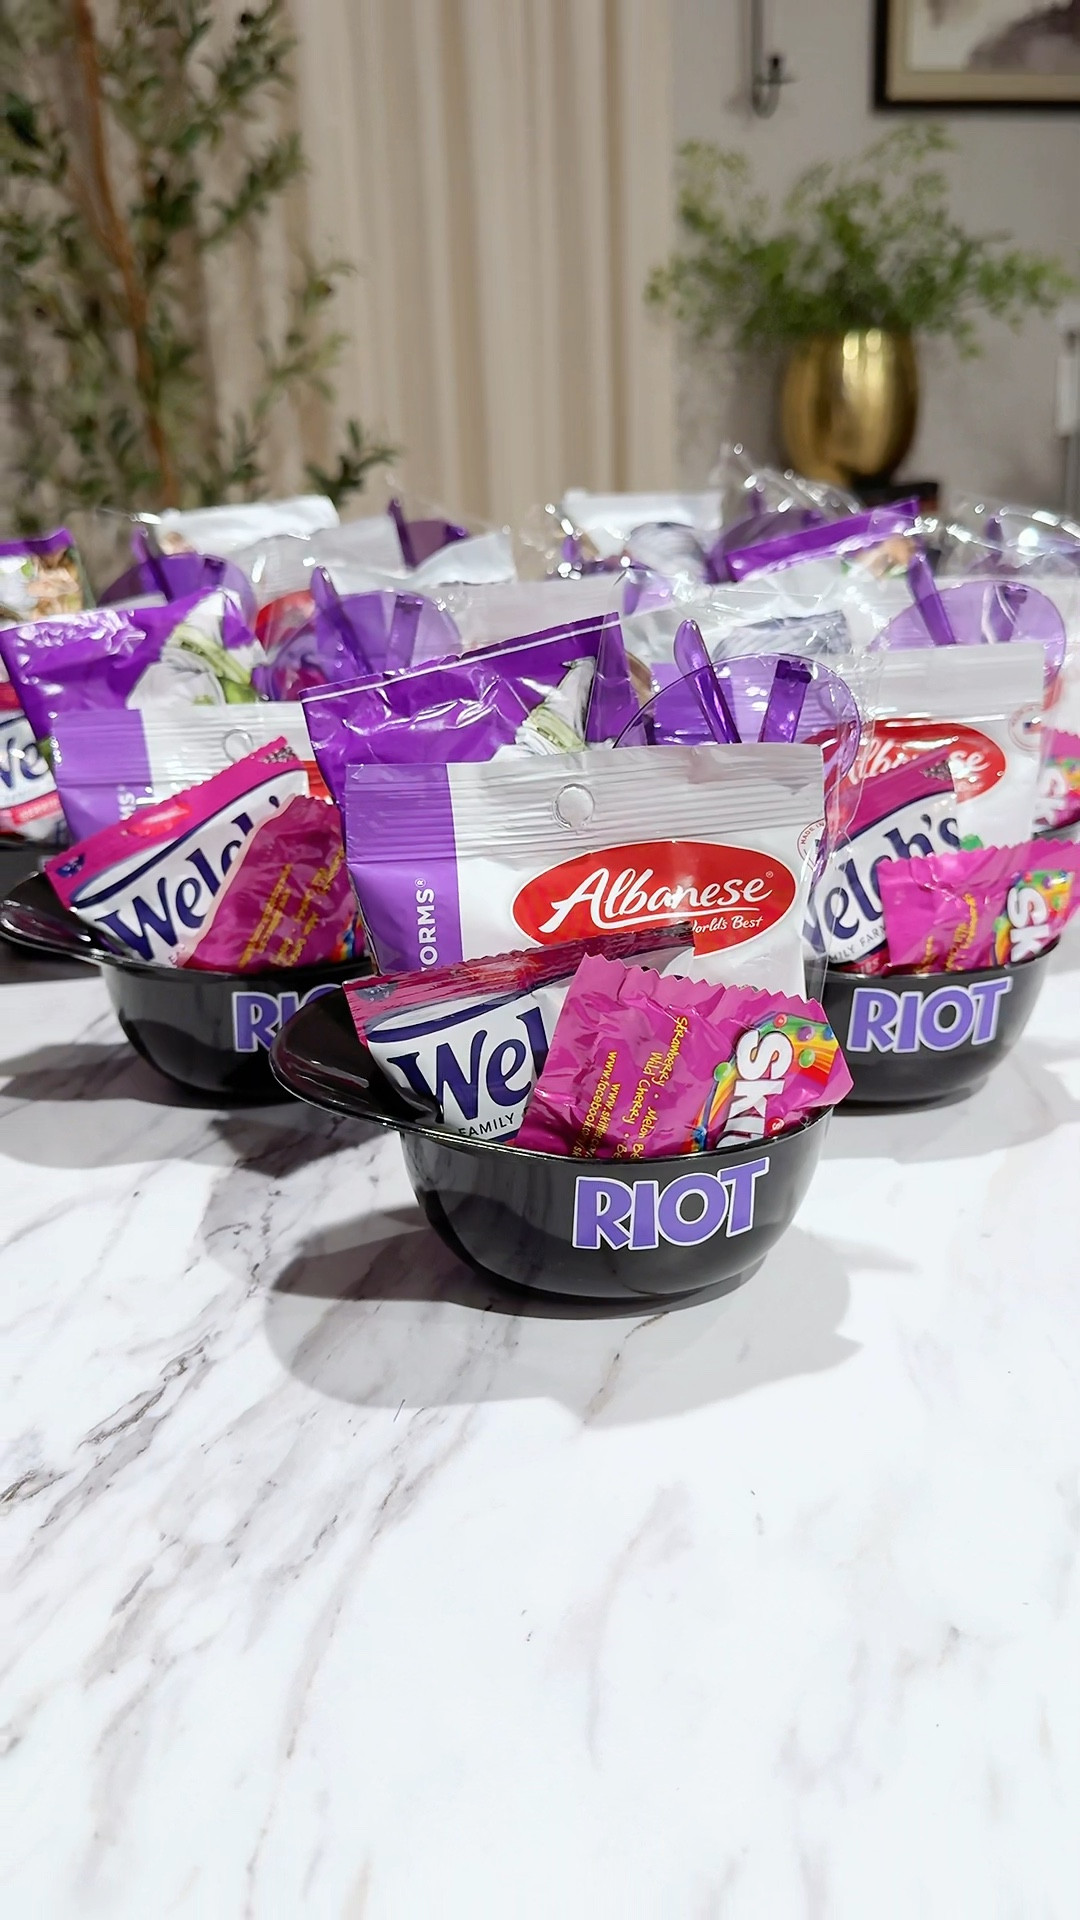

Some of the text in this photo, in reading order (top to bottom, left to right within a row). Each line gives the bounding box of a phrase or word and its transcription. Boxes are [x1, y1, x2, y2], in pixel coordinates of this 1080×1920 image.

[415, 877, 438, 972] ORMS®
[731, 915, 764, 930] Best
[846, 977, 1013, 1053] RIOT
[643, 1051, 663, 1076] Wild
[651, 1016, 689, 1087] Strawberry
[458, 1112, 515, 1137] FAMILY
[622, 1078, 651, 1125] Cherry
[638, 1106, 658, 1138] Melon
[572, 1157, 771, 1251] RIOT
